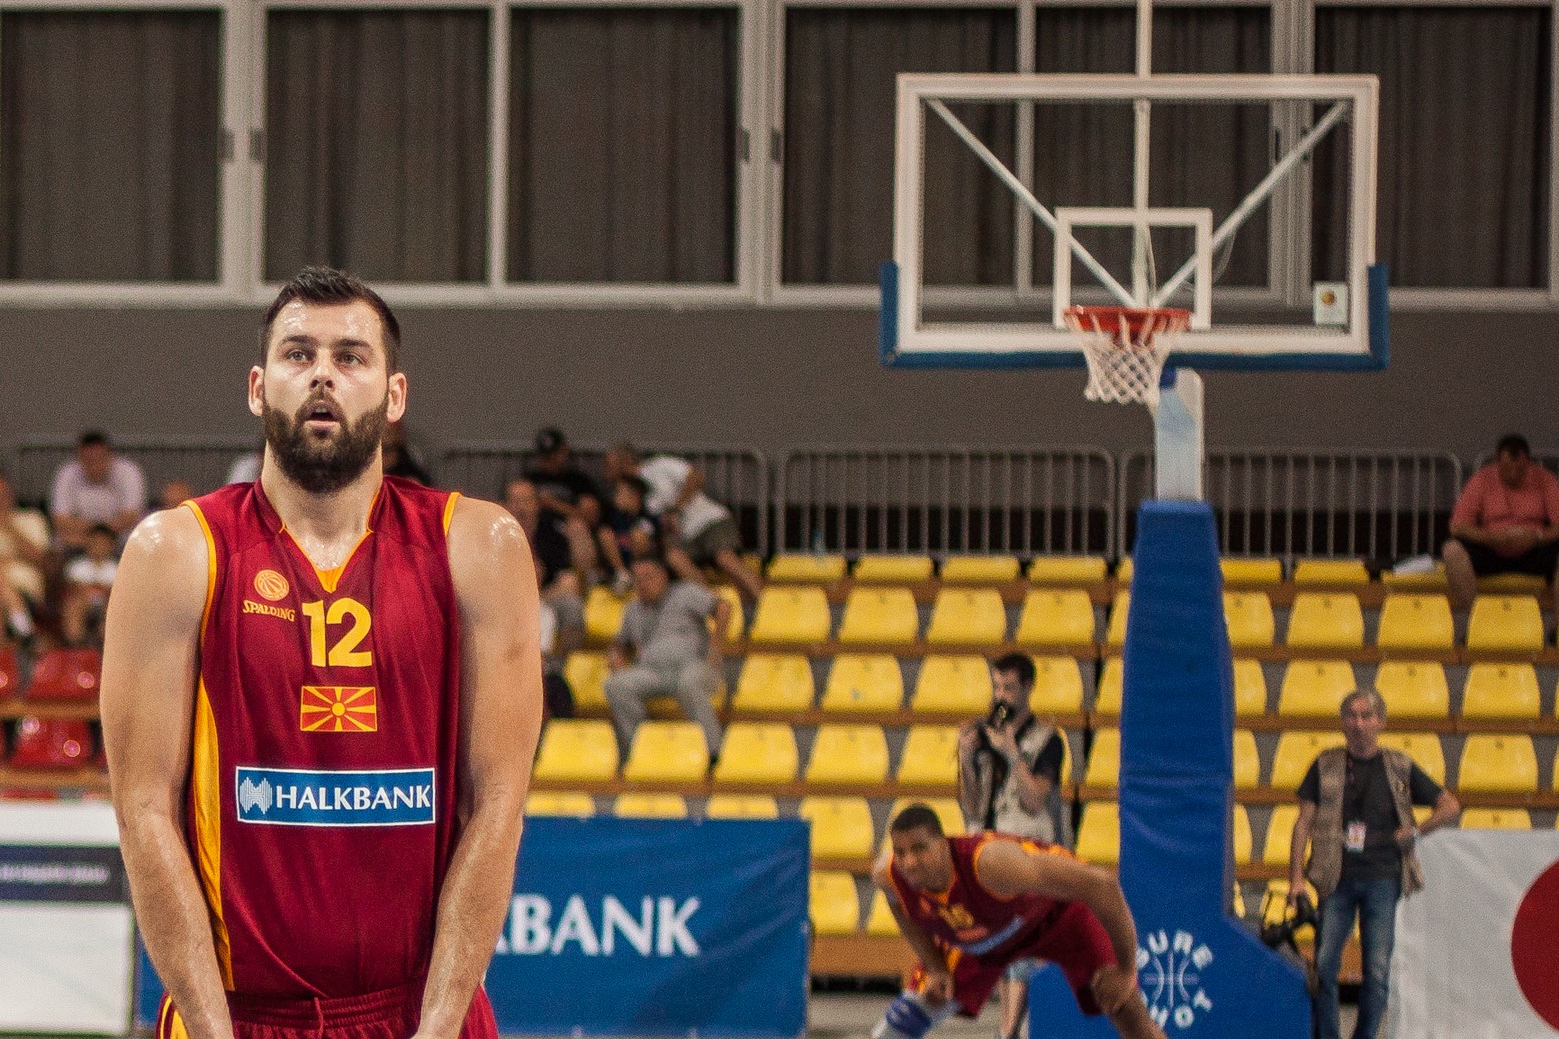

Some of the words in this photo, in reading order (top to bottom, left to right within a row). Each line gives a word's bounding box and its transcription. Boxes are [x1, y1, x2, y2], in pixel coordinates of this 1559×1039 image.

[242, 600, 296, 622] SPALDING
[302, 597, 373, 668] 12
[276, 784, 431, 811] HALKBANK
[495, 893, 701, 957] BANK
